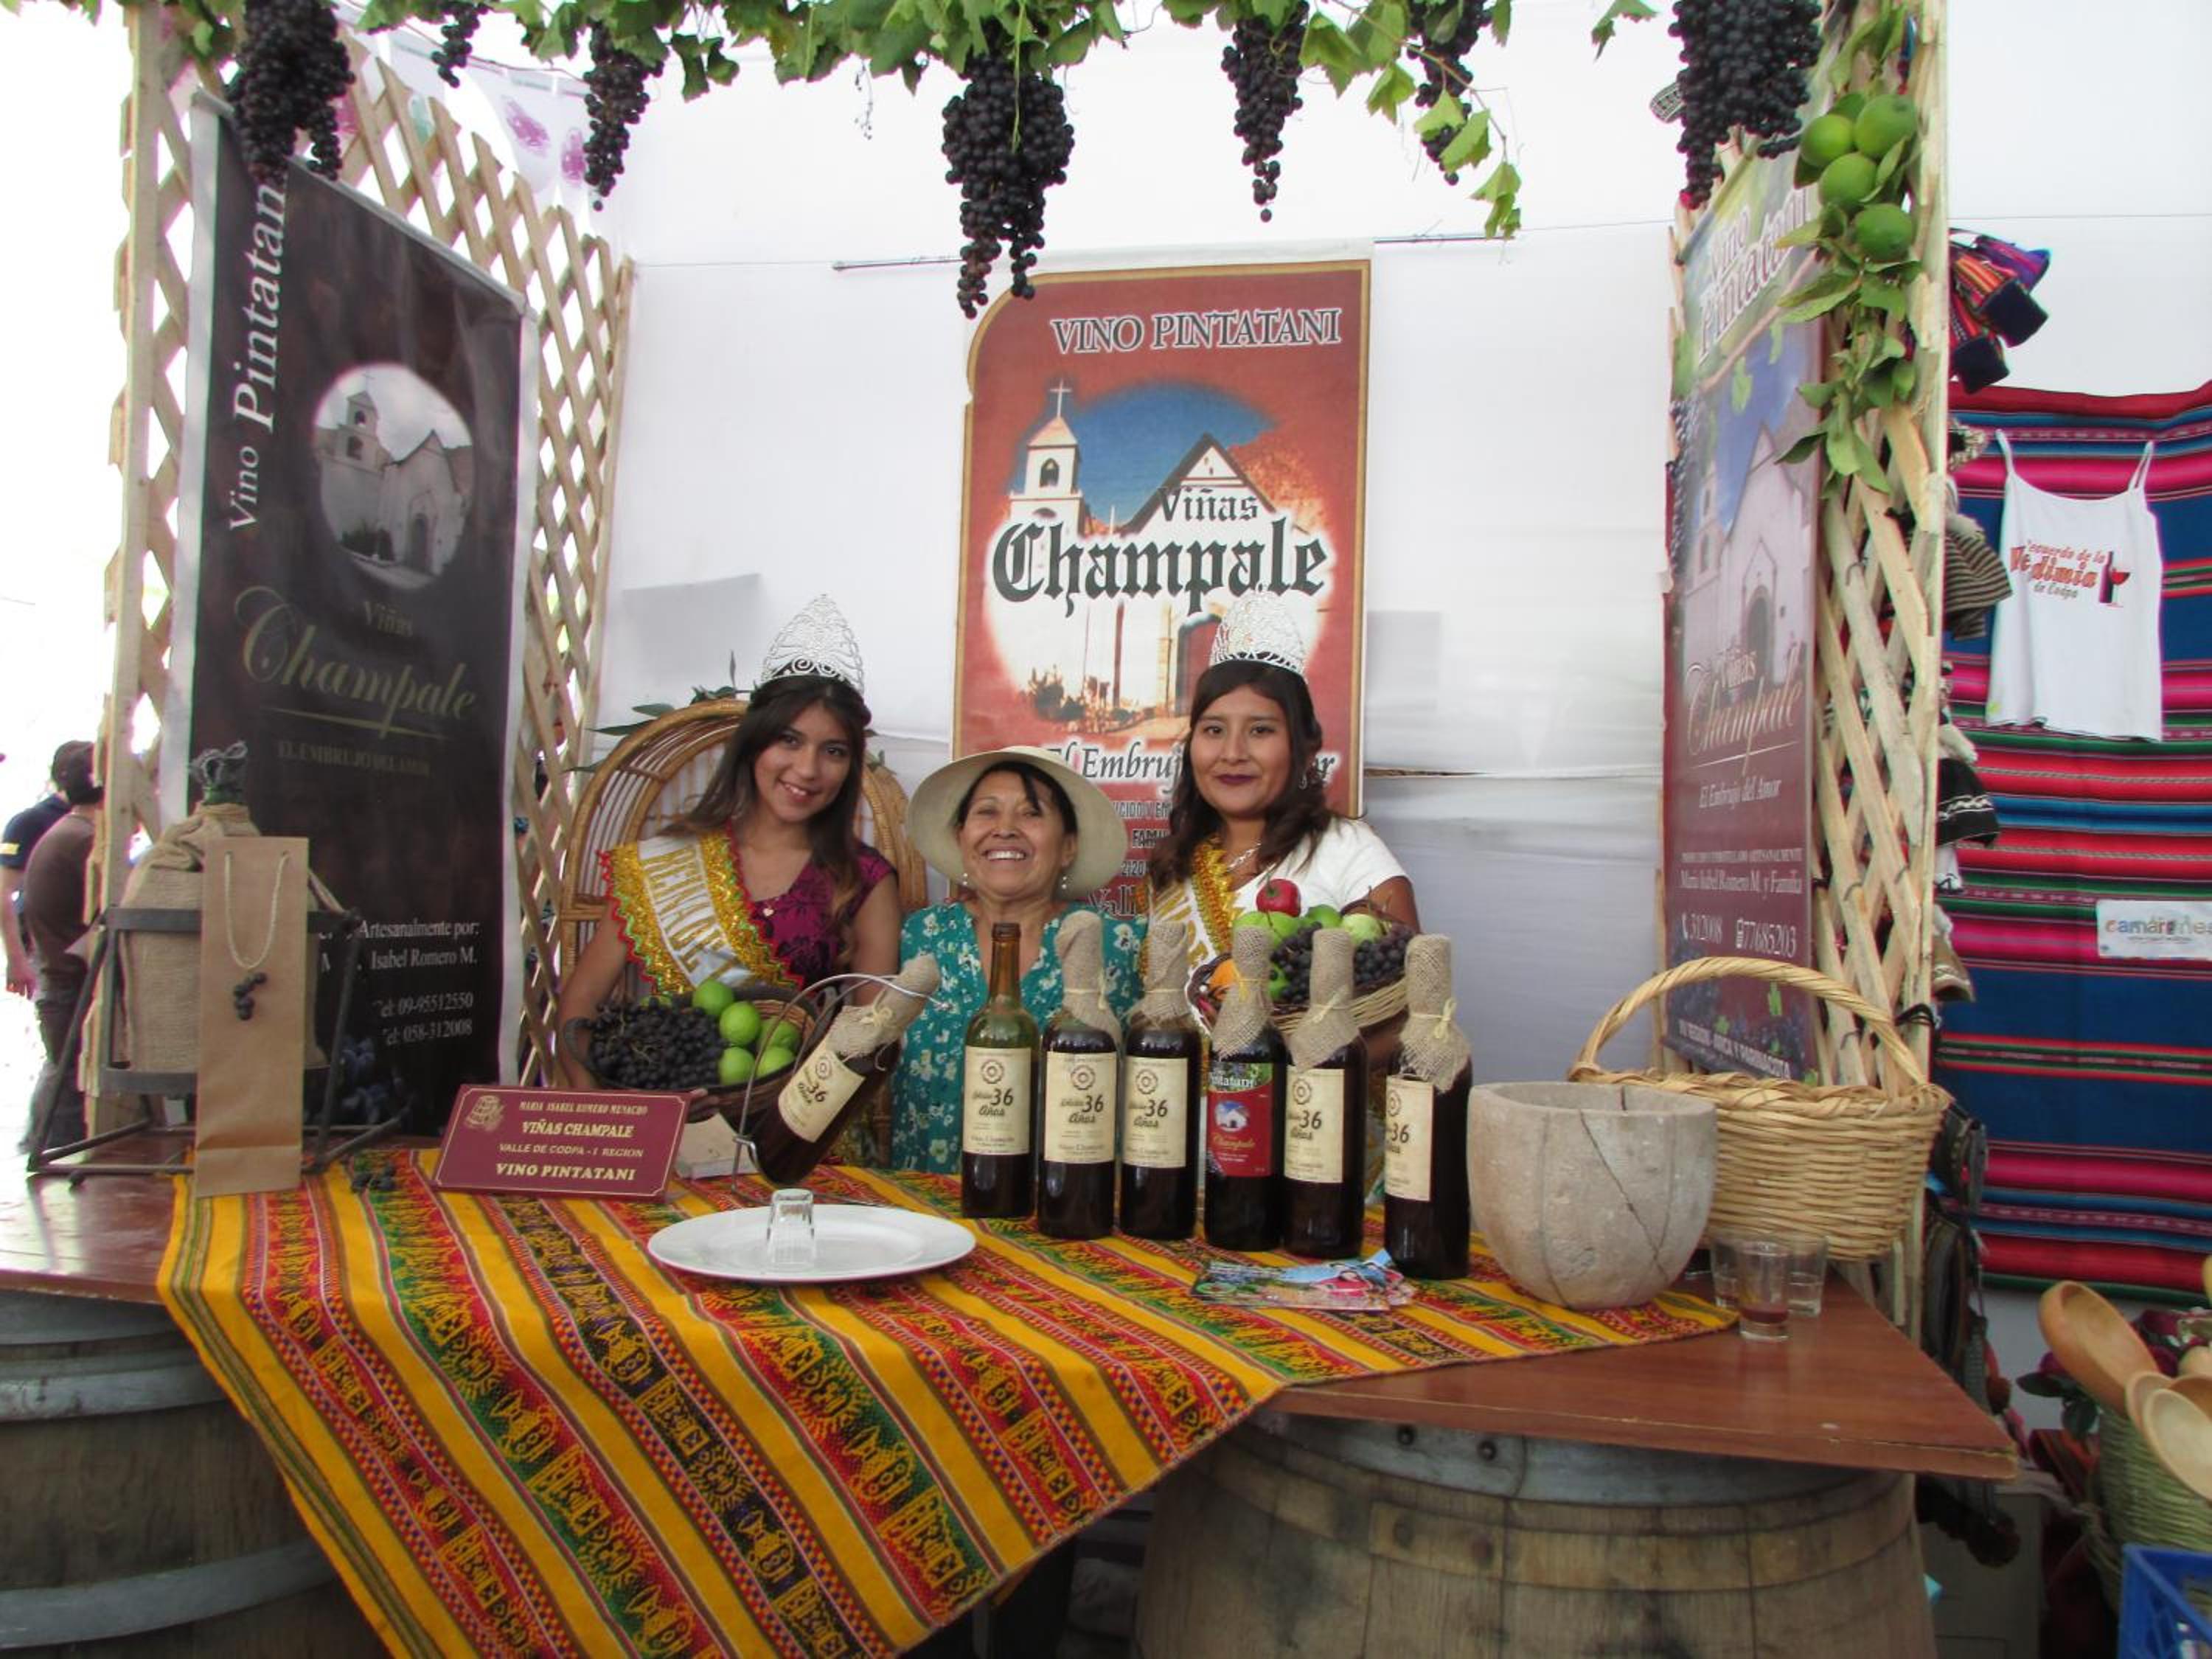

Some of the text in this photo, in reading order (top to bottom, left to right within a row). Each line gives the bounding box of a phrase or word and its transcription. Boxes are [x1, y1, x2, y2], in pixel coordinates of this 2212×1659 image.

[1709, 204, 1750, 277] Vino
[1051, 308, 1343, 354] VINO PINTATANI
[229, 172, 288, 531] Vino Pintatan
[1158, 487, 1259, 522] Viñas
[992, 515, 1328, 619] Champale
[234, 586, 476, 740] Champale
[1082, 742, 1183, 794] Embruj
[371, 947, 407, 970] Isabel
[411, 947, 456, 967] Romero
[807, 1081, 827, 1102] 36
[990, 1088, 1014, 1106] 36
[1082, 1094, 1105, 1113] 36
[1144, 1099, 1169, 1117] 36
[522, 1119, 635, 1138] VIÑAS CHAMPALE
[1298, 1109, 1322, 1130] 36
[1391, 1121, 1410, 1144] 36
[498, 1143, 532, 1153] VALLE
[532, 1144, 549, 1154] DE
[600, 1148, 644, 1157] REGION
[495, 1163, 637, 1181] VINO PINTATANI
